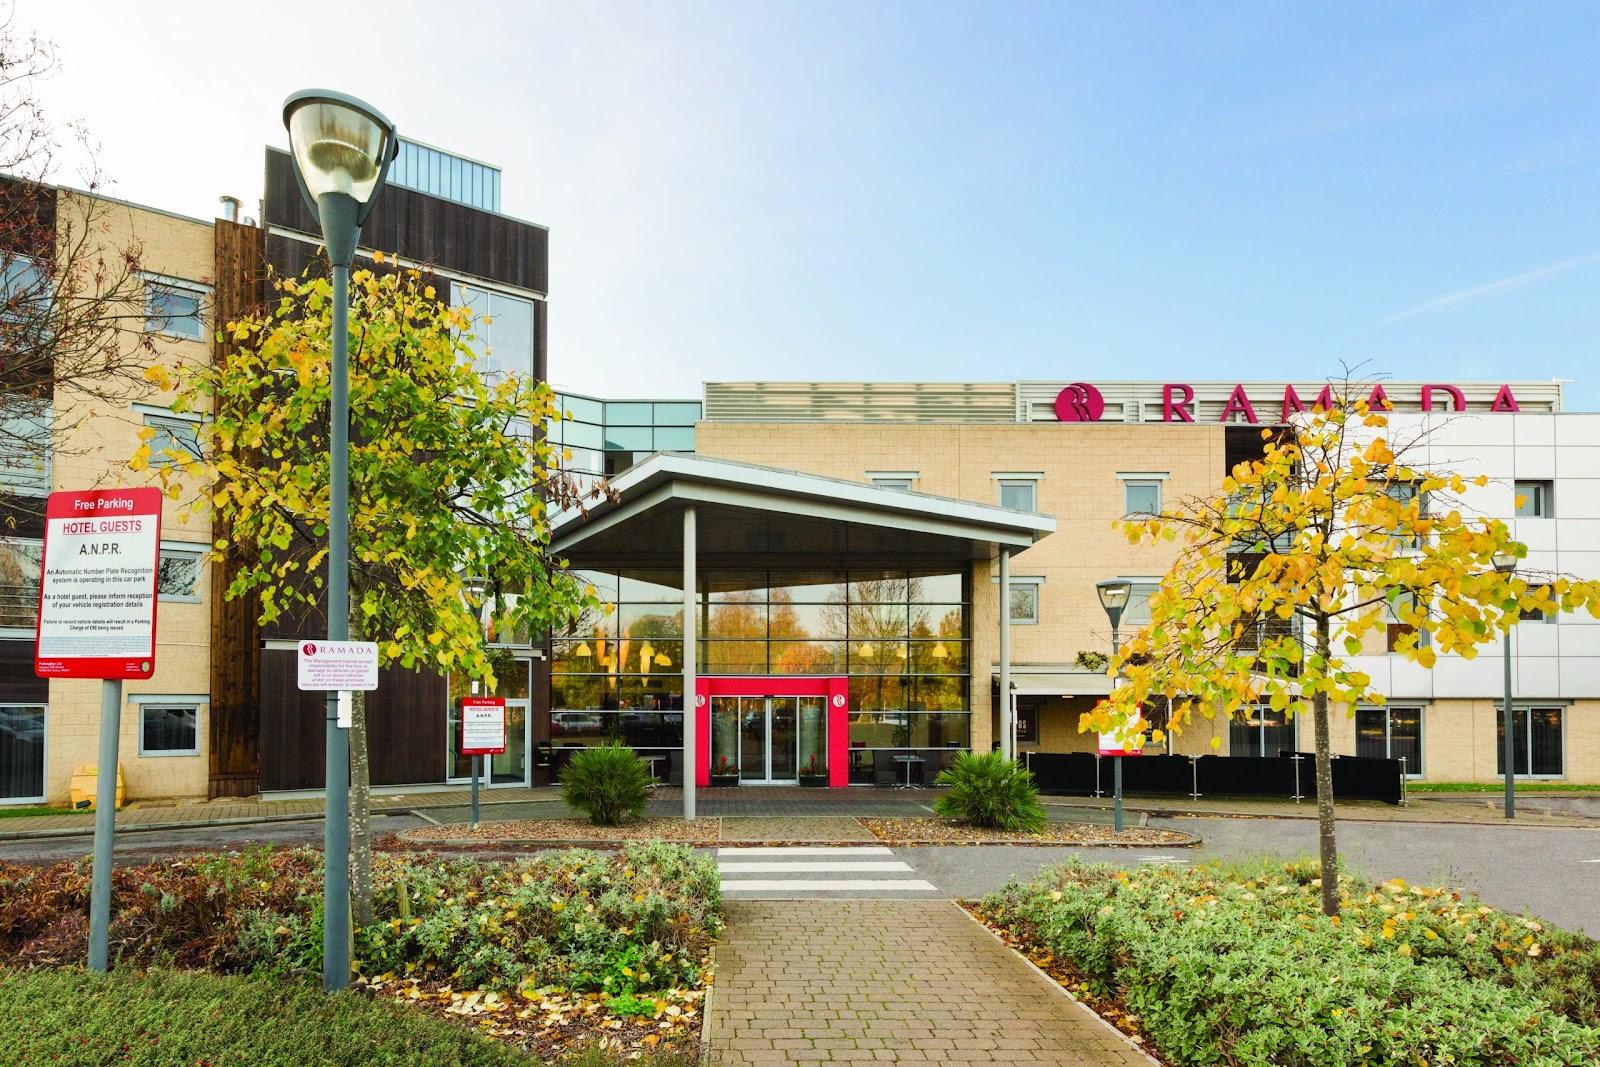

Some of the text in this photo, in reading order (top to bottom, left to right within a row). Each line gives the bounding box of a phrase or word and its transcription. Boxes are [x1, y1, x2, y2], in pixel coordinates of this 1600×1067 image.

[1162, 384, 1520, 423] RAMADA
[74, 498, 134, 510] Free Parking
[63, 520, 142, 534] HOTEL GUESTS
[80, 543, 122, 555] A.N.P.R.
[79, 576, 105, 584] operating
[134, 574, 146, 583] park
